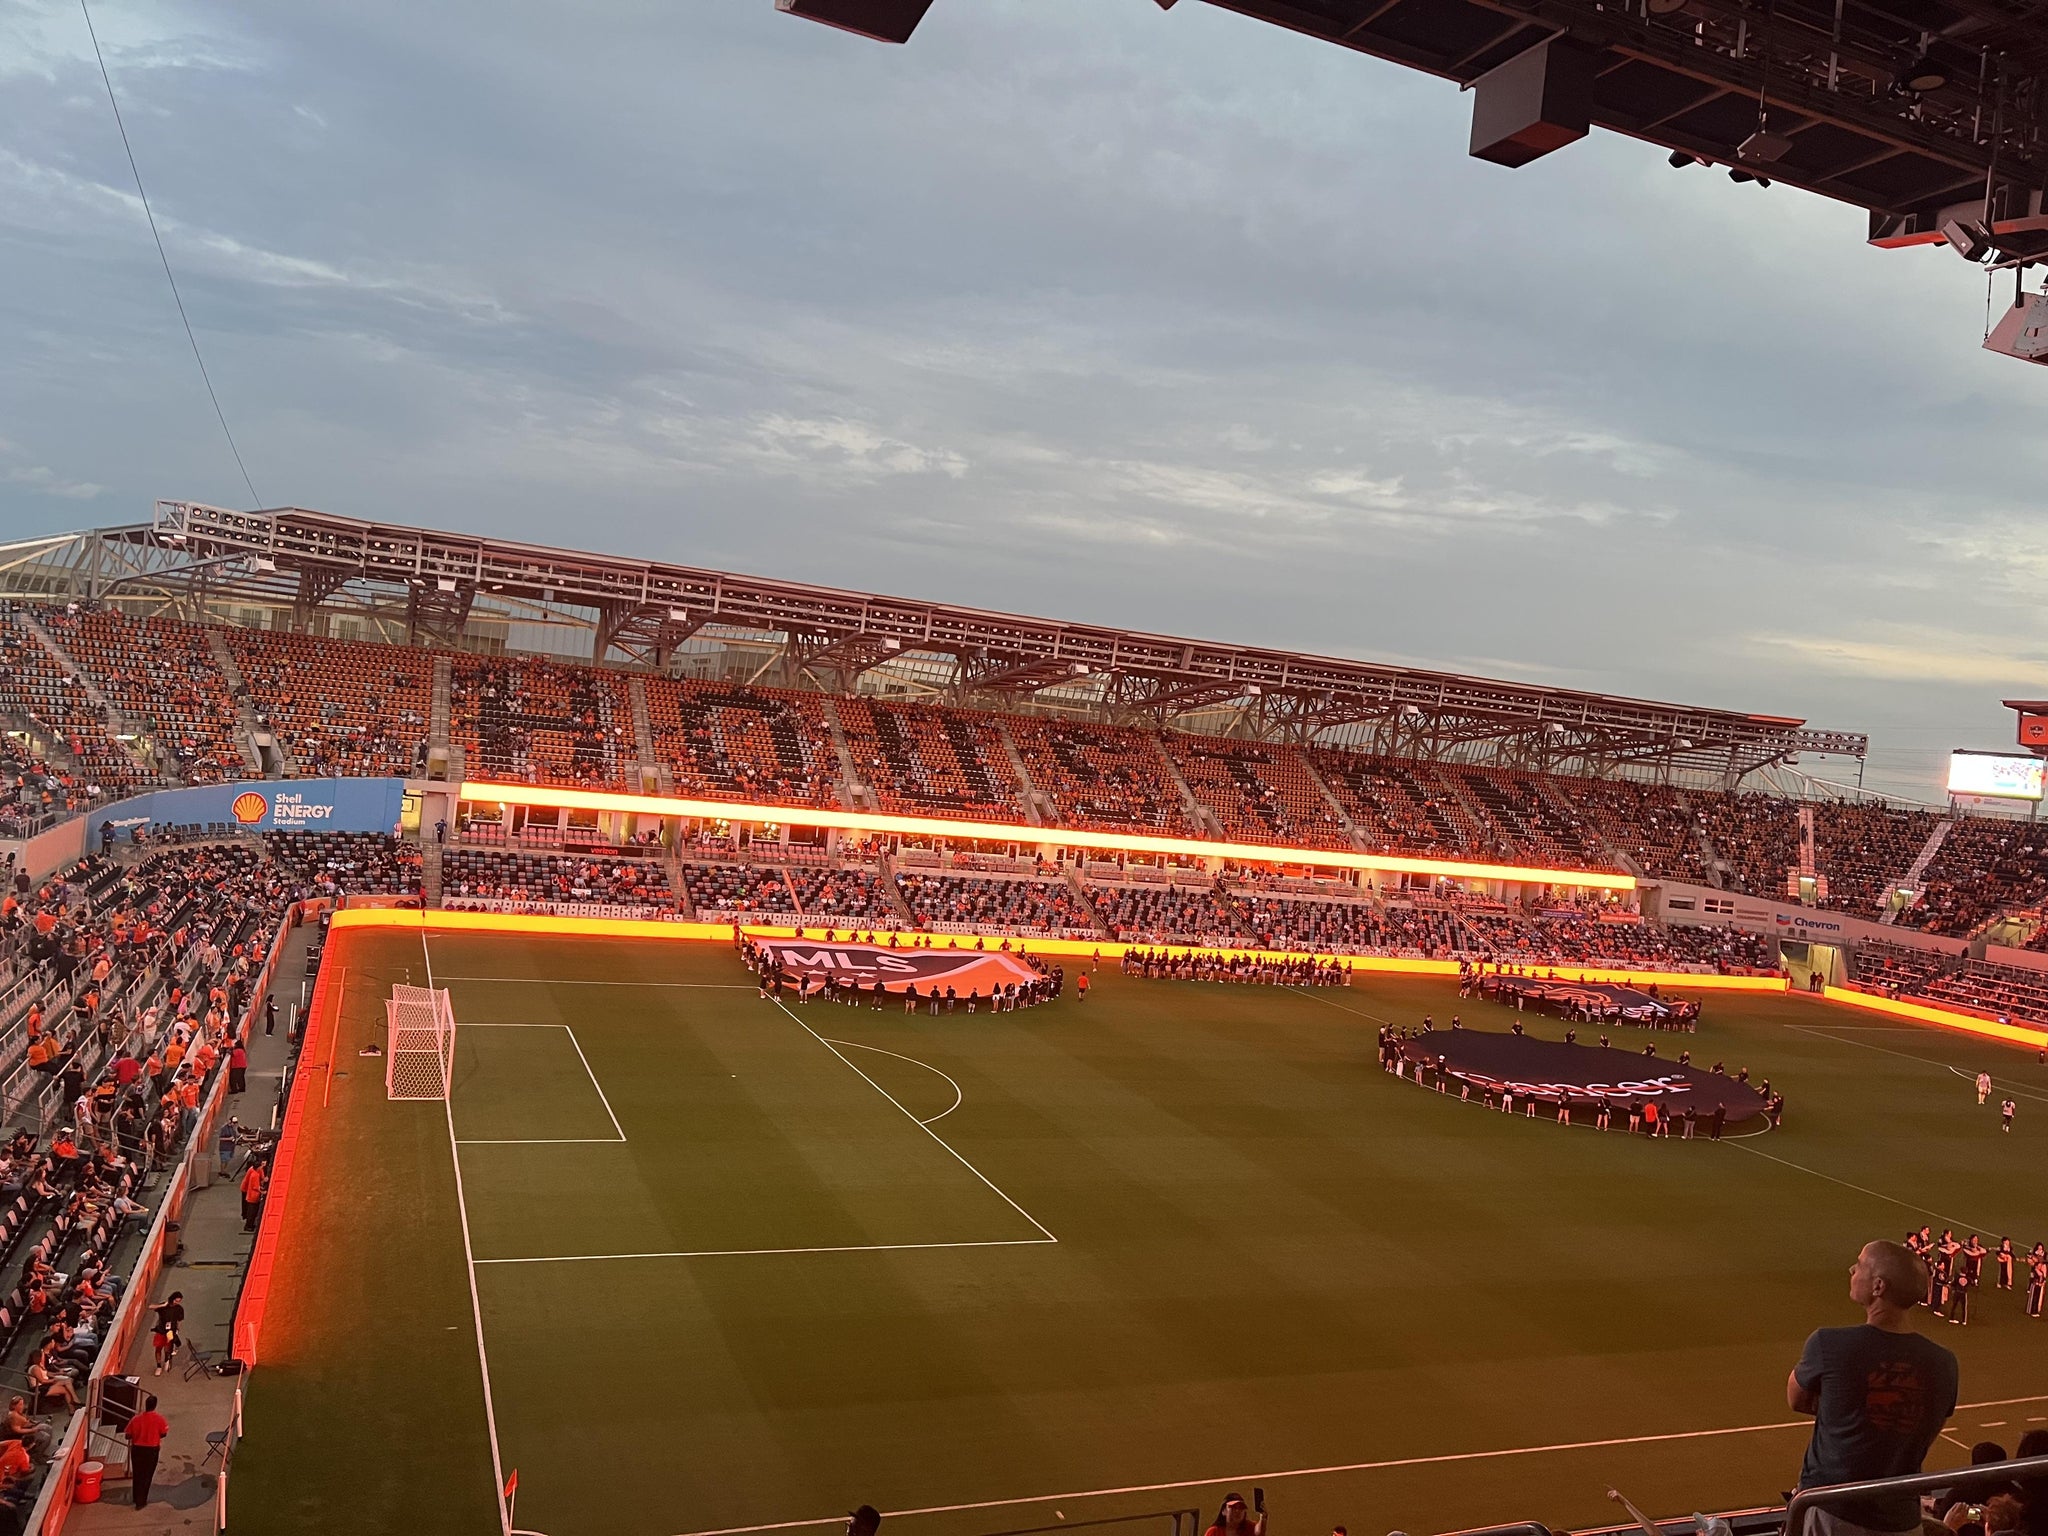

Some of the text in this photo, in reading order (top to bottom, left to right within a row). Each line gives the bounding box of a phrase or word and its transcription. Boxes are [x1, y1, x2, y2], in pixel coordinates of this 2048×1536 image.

[275, 793, 302, 804] Shell
[273, 804, 334, 819] ENERGY
[272, 817, 306, 826] Stadium
[591, 847, 618, 855] verizon
[1794, 917, 1840, 932] Chevron
[781, 950, 918, 972] MLS
